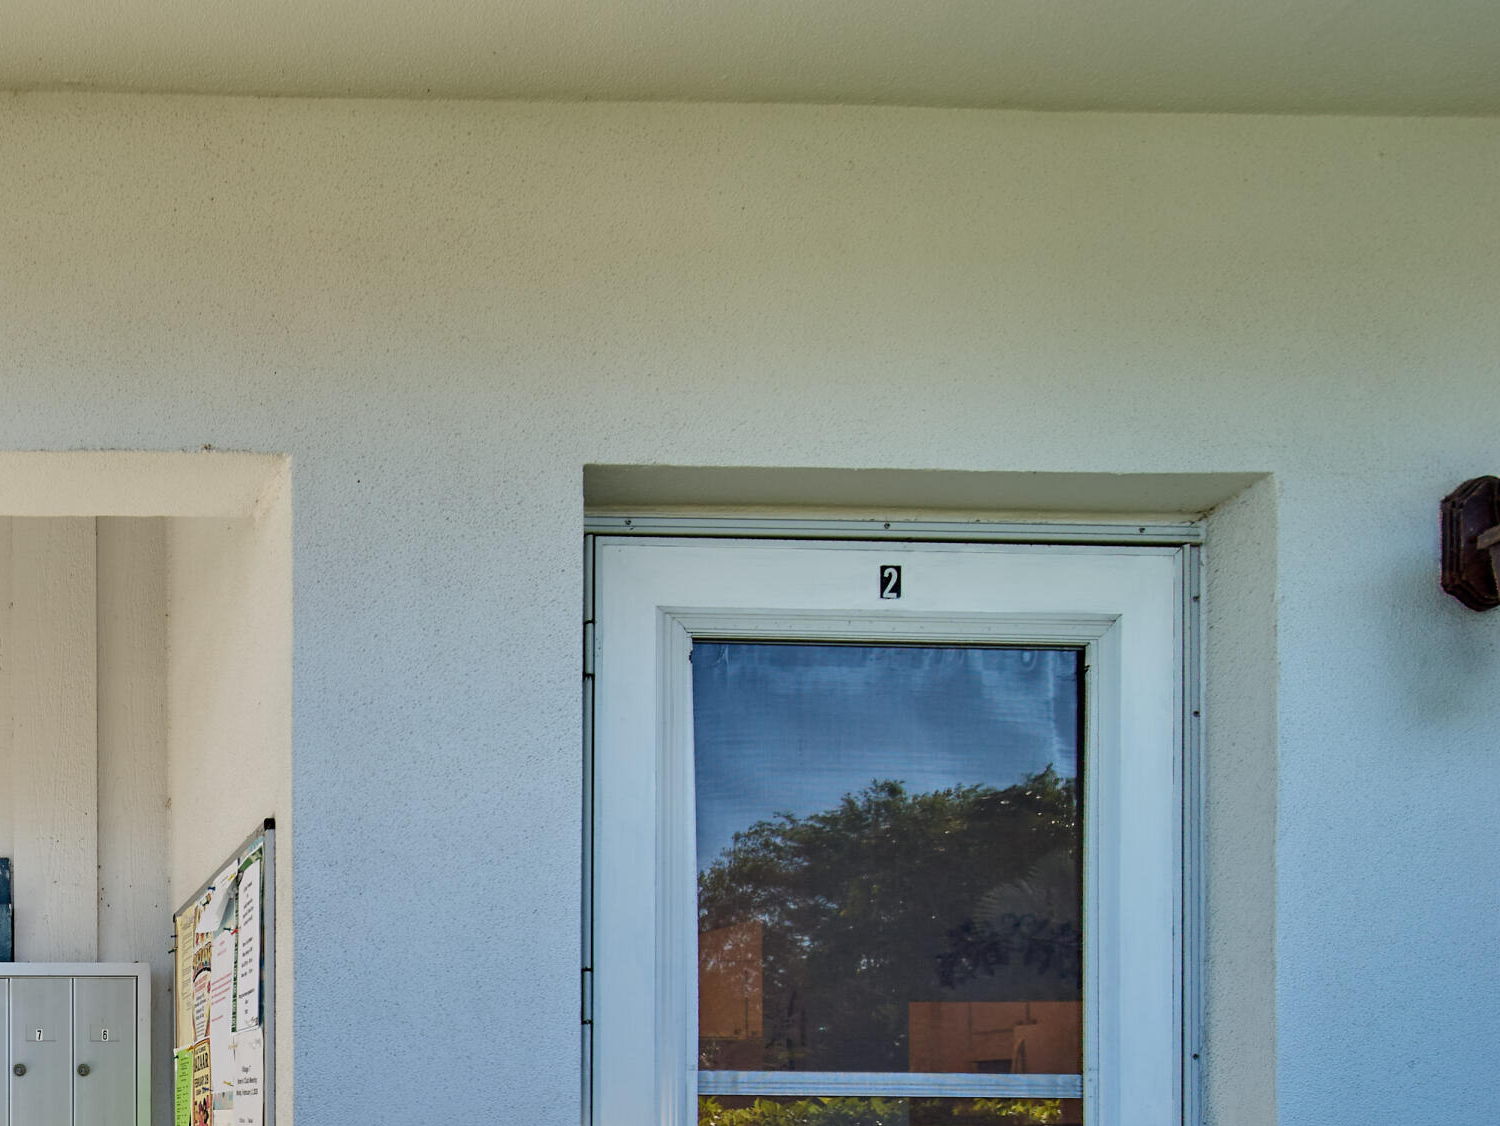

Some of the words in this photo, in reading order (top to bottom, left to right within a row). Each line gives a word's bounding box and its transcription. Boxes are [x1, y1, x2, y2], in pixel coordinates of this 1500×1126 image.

[882, 567, 898, 598] 2
[37, 1030, 42, 1040] 7
[102, 1030, 107, 1040] 6
